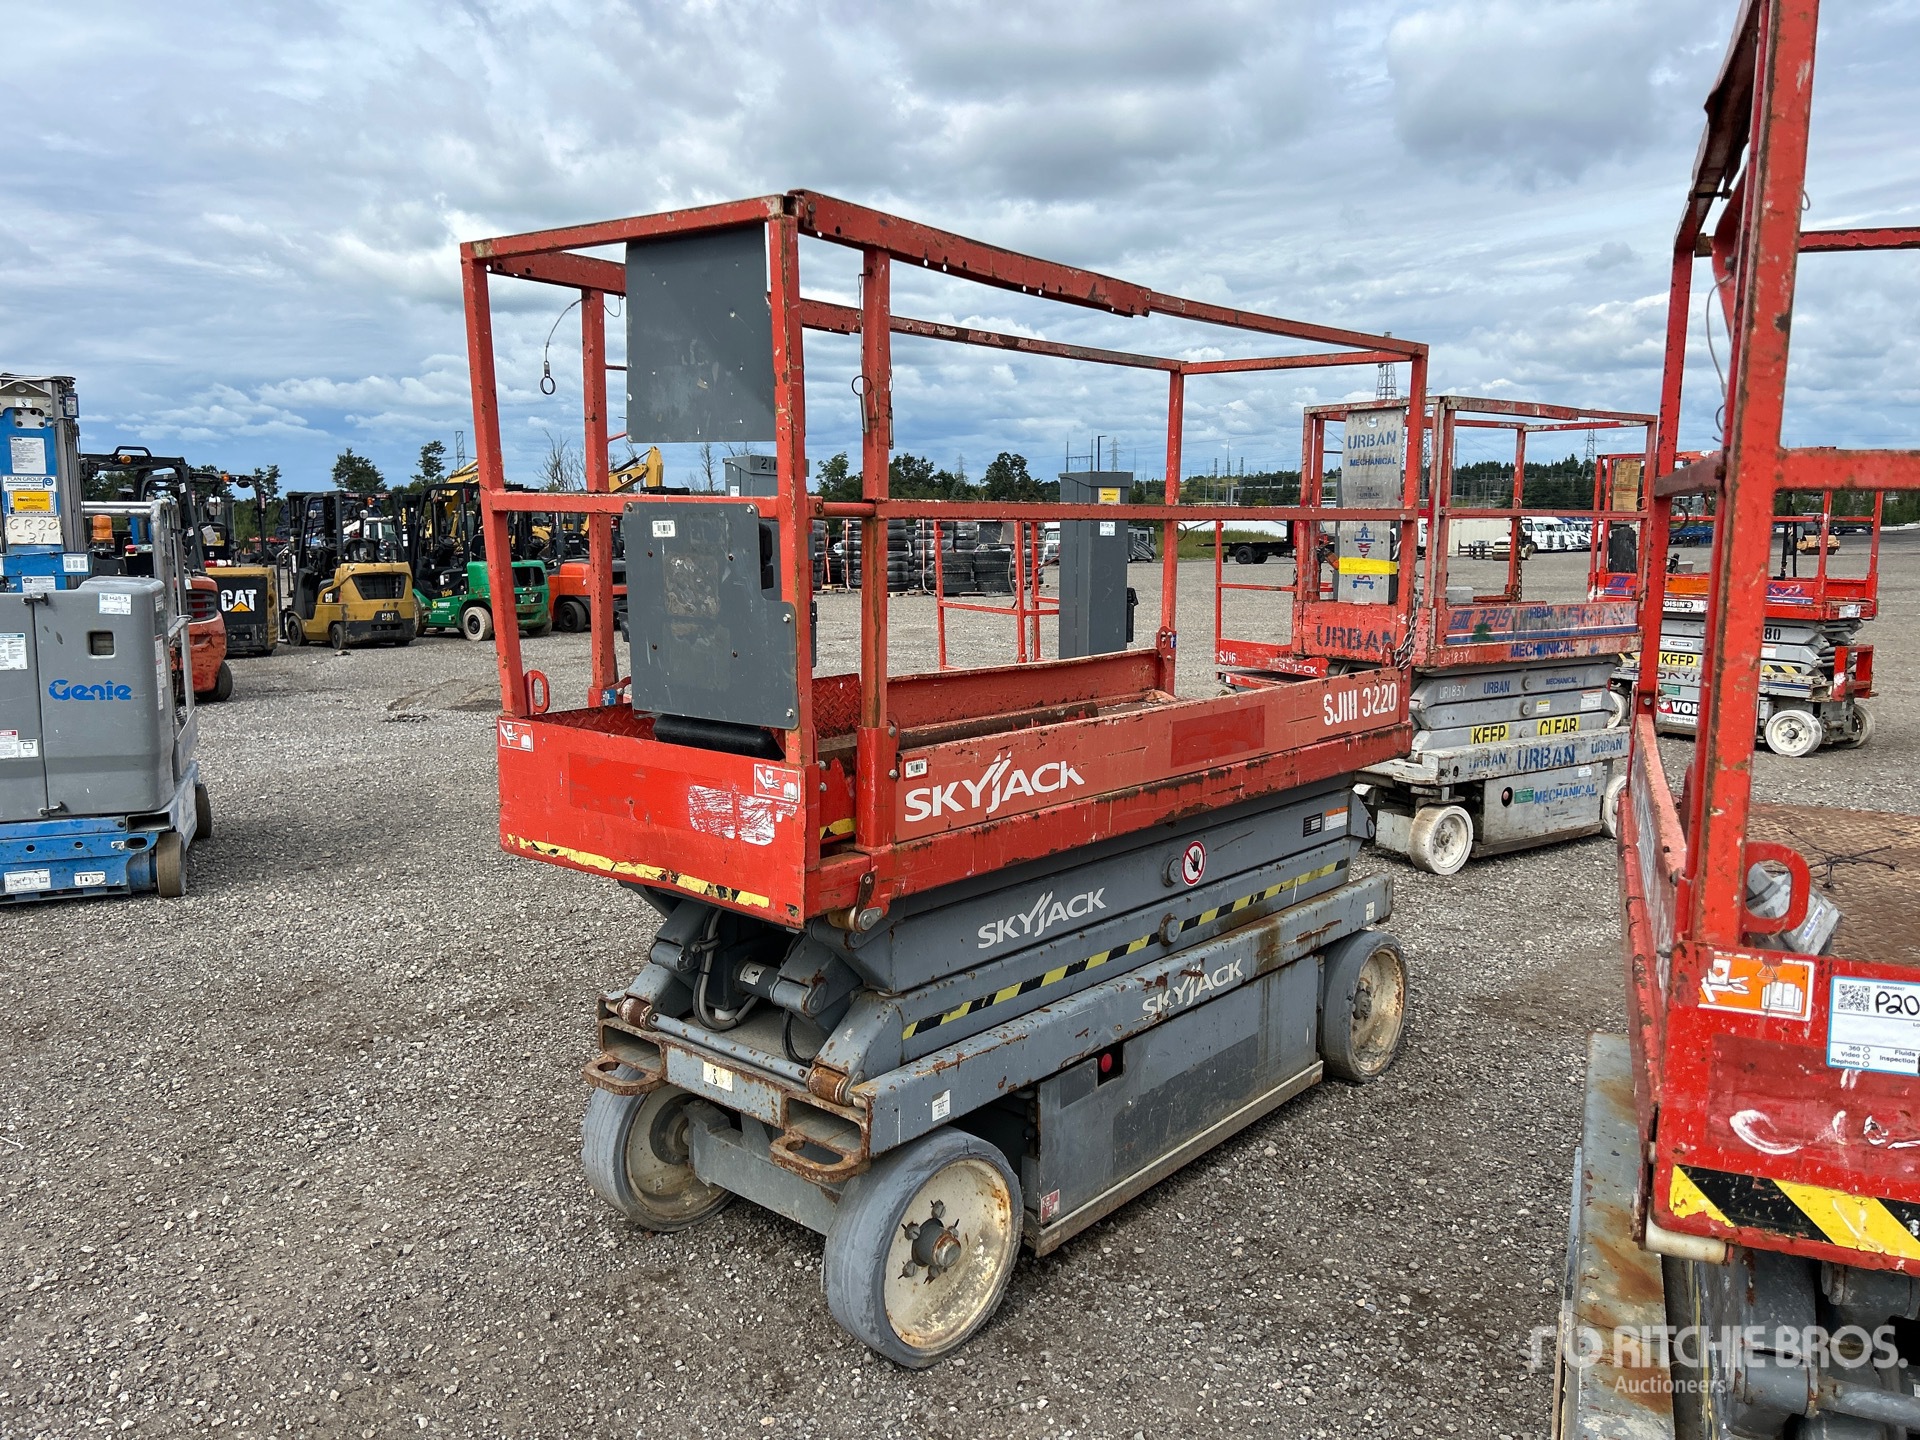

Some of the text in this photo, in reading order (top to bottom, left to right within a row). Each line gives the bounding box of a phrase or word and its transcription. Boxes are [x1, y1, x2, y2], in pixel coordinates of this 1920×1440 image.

[1348, 430, 1397, 449] URBAN
[1350, 457, 1397, 467] MECHANICAL
[221, 590, 257, 612] CAT
[1663, 600, 1693, 608] OISIN'S
[381, 612, 395, 621] CAT
[1316, 625, 1397, 652] URBAN
[1764, 628, 1781, 640] 80
[1218, 650, 1237, 664] SJ16
[1661, 653, 1694, 666] KEEP
[1483, 681, 1511, 695] URBAN
[1545, 676, 1577, 686] MECHANICAL
[49, 679, 132, 701] Genie
[1362, 682, 1397, 718] 3220
[1473, 723, 1507, 744] KEEP
[1539, 717, 1577, 736] CLEAR
[1590, 738, 1623, 755] URBAN
[1468, 752, 1507, 769] URBAN
[1516, 743, 1576, 771] URBAN
[904, 751, 1085, 822] SKYJACK
[1534, 784, 1597, 804] MECHANICAL
[977, 888, 1107, 949] SKYJACK
[1142, 958, 1244, 1021] SKYJACK
[1830, 1057, 1860, 1066] Rephoto
[1879, 1055, 1916, 1064] Inspection
[1894, 1049, 1916, 1057] Fluids
